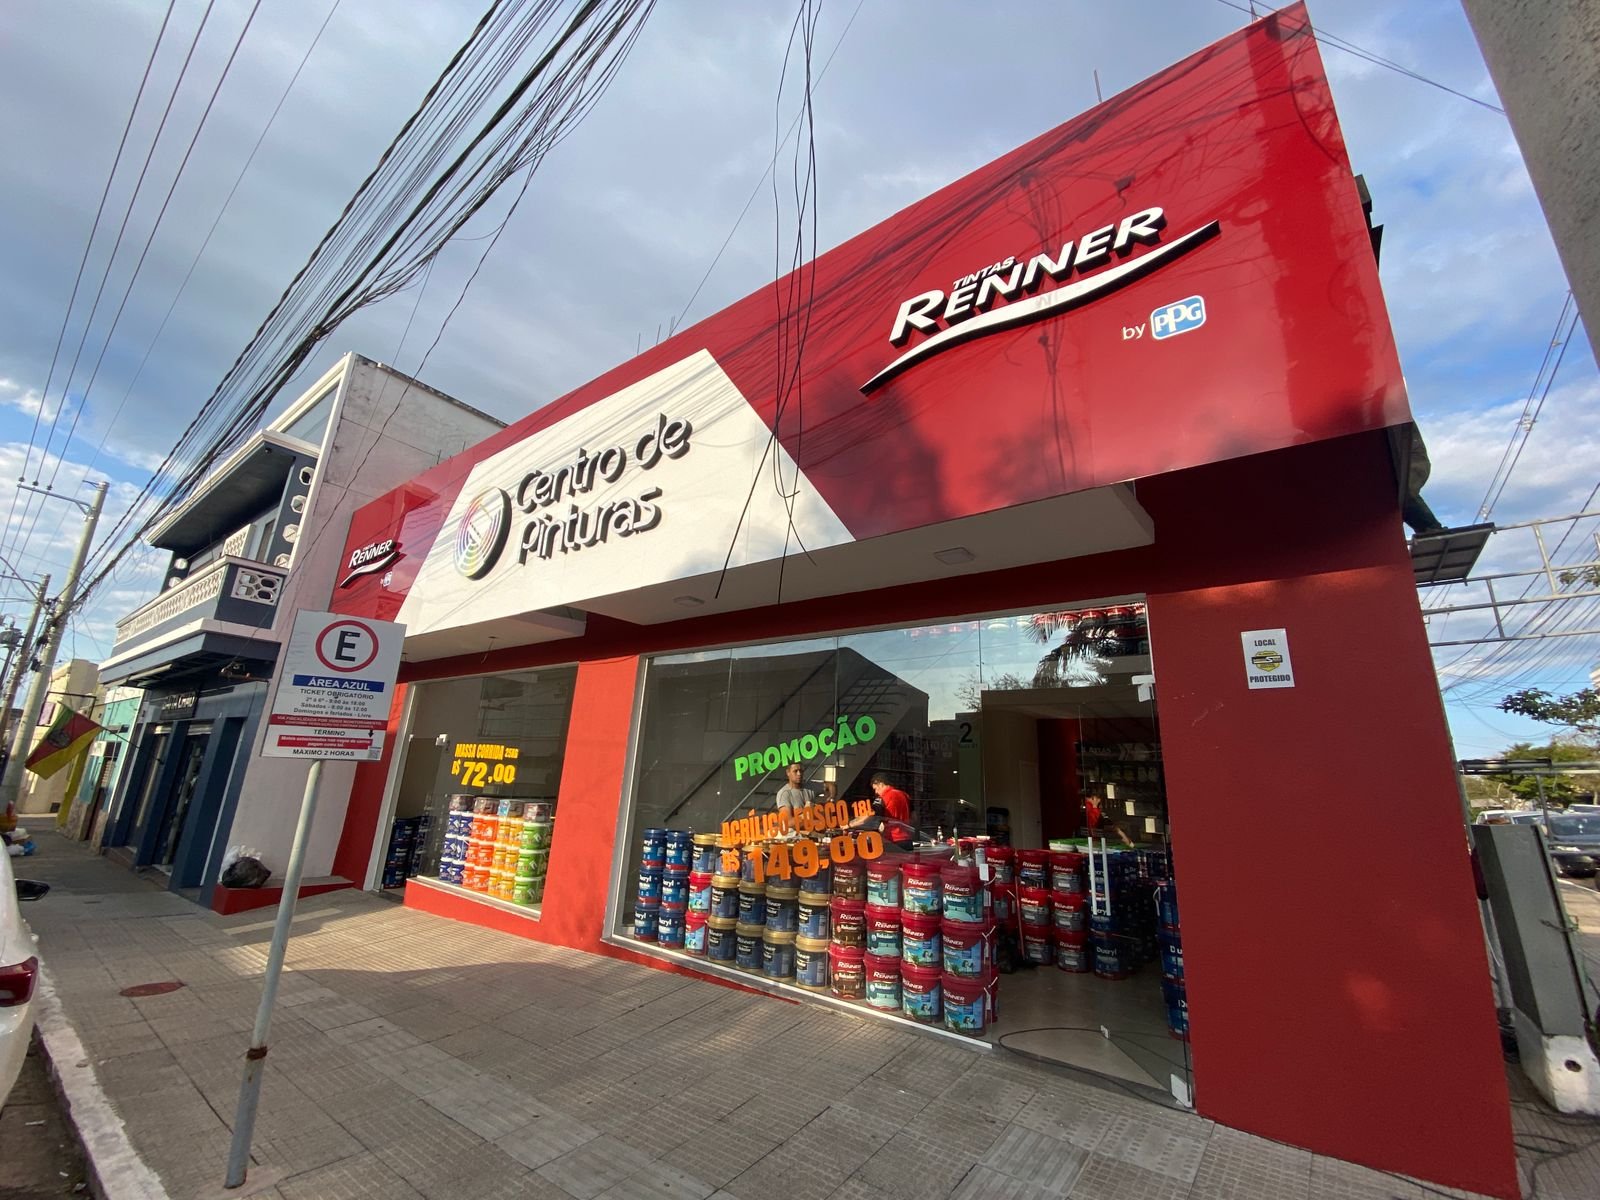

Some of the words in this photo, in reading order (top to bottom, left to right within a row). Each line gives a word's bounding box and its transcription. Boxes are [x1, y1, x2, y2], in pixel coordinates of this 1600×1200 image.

[889, 206, 1166, 346] RENNER
[952, 256, 1015, 290] TINTAS
[1122, 322, 1145, 341] by
[1155, 300, 1203, 334] PPG
[516, 447, 627, 514] Centro
[634, 412, 693, 470] de
[518, 486, 663, 566] pinturas
[348, 540, 394, 568] RENNER
[335, 630, 361, 662] E
[1254, 639, 1276, 647] LOCAL
[300, 688, 325, 696] TICKET
[308, 677, 340, 688] ÁREA
[341, 681, 370, 691] AZUL
[1249, 674, 1291, 683] PROTEGIDO
[959, 722, 973, 743] 2
[455, 744, 477, 758] MASSA
[477, 744, 504, 760] CORRIDA
[734, 715, 877, 781] PROMOÇÃO
[461, 761, 516, 787] 72,00
[721, 809, 789, 845] ACRÍLICO
[794, 800, 849, 835] FOSCO
[851, 799, 875, 817] 18L
[720, 848, 741, 873] R$
[748, 831, 884, 884] 149,00
[908, 878, 933, 886] RENNER
[945, 883, 970, 892] RENNER
[874, 971, 898, 979] RENNER
